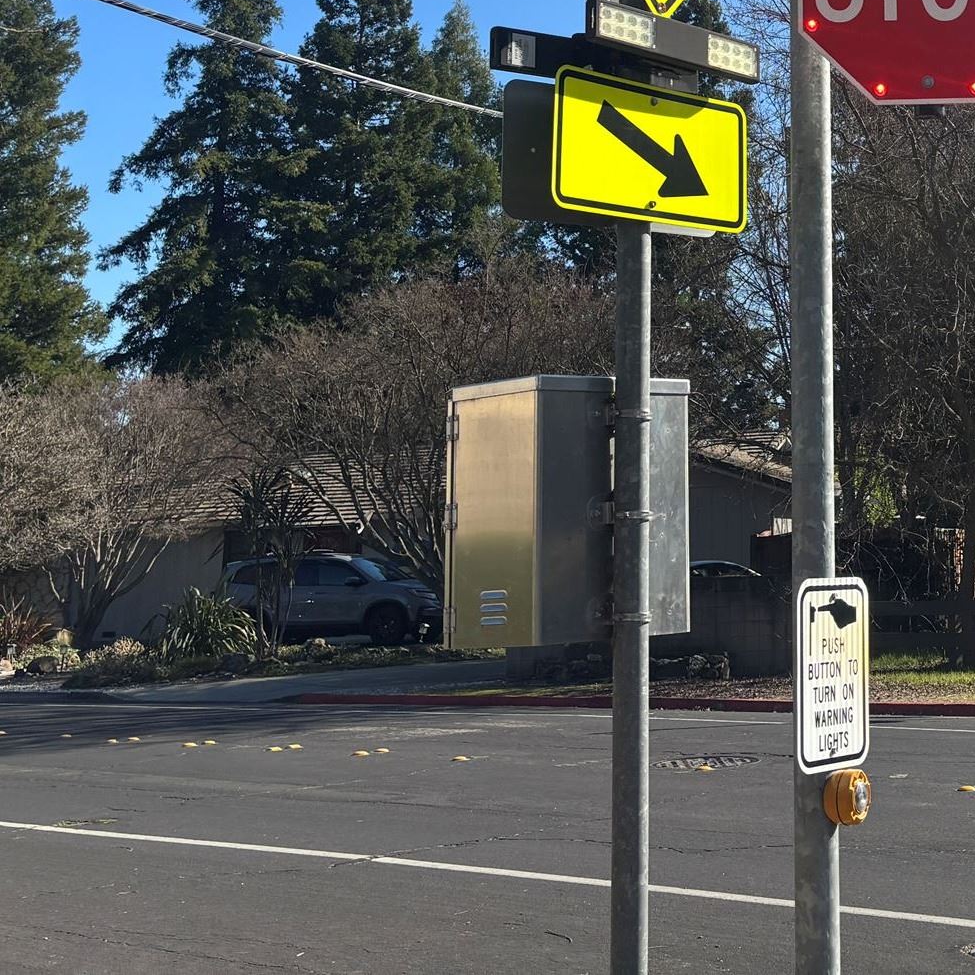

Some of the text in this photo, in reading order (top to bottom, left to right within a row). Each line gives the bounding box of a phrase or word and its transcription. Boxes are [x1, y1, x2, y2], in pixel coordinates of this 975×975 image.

[822, 637, 845, 655] PUSH
[808, 659, 859, 681] BUTTON TO
[813, 683, 854, 704] TURN ON
[814, 706, 853, 728] WARNING
[819, 731, 849, 752] LIGHTS
